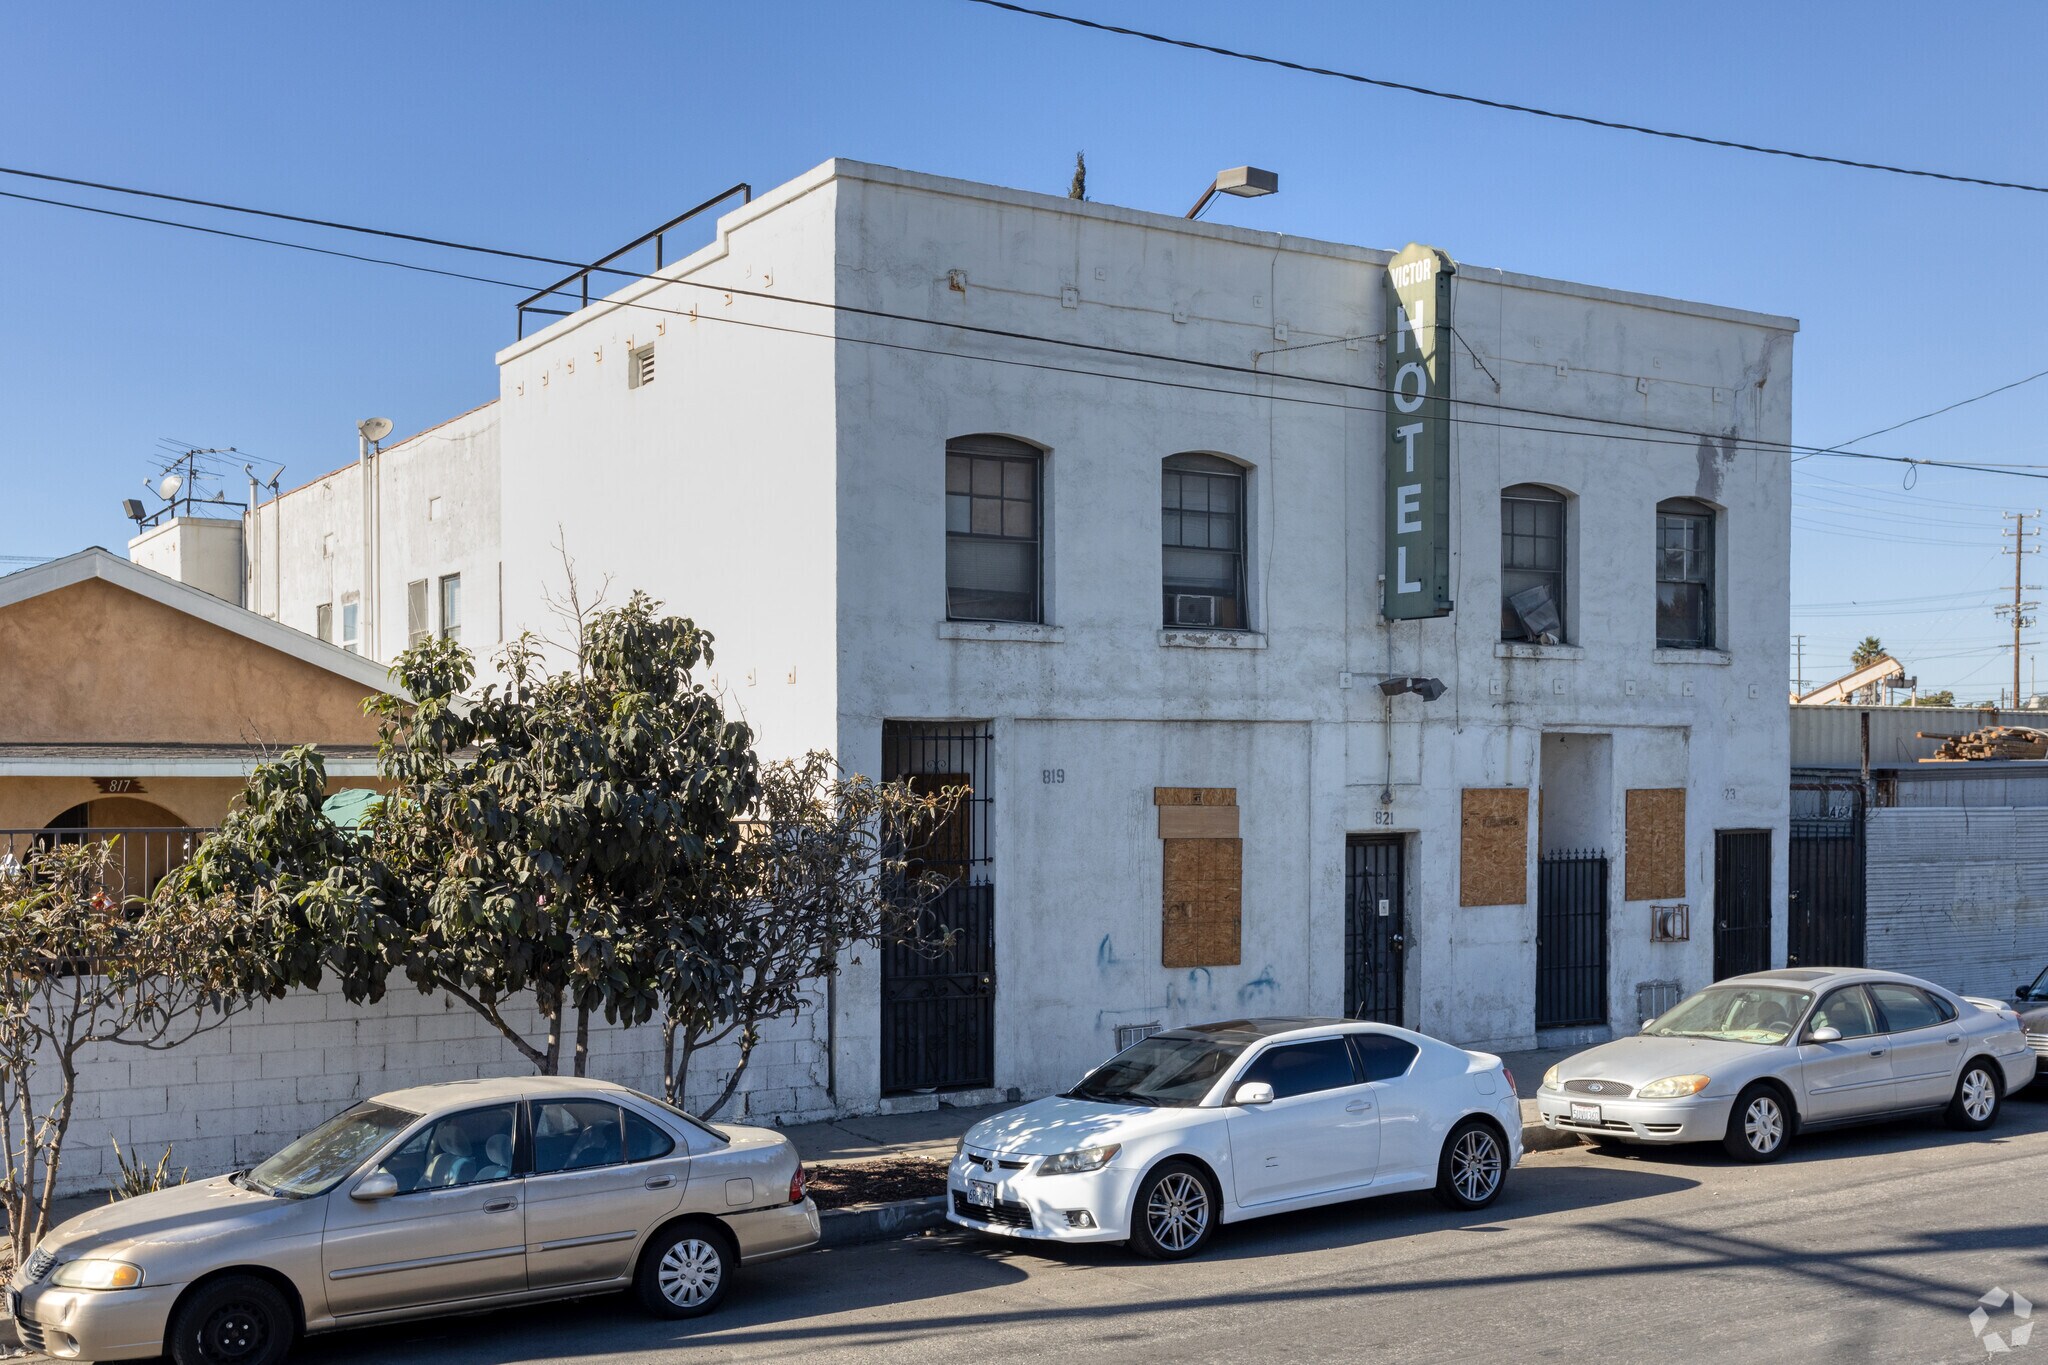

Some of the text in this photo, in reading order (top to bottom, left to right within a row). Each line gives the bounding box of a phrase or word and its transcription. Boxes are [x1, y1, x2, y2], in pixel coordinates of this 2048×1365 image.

[1391, 258, 1431, 289] VICTOR
[1393, 300, 1427, 594] HOTEL
[1042, 768, 1065, 784] 819
[109, 779, 131, 792] 817
[1375, 811, 1394, 825] 821
